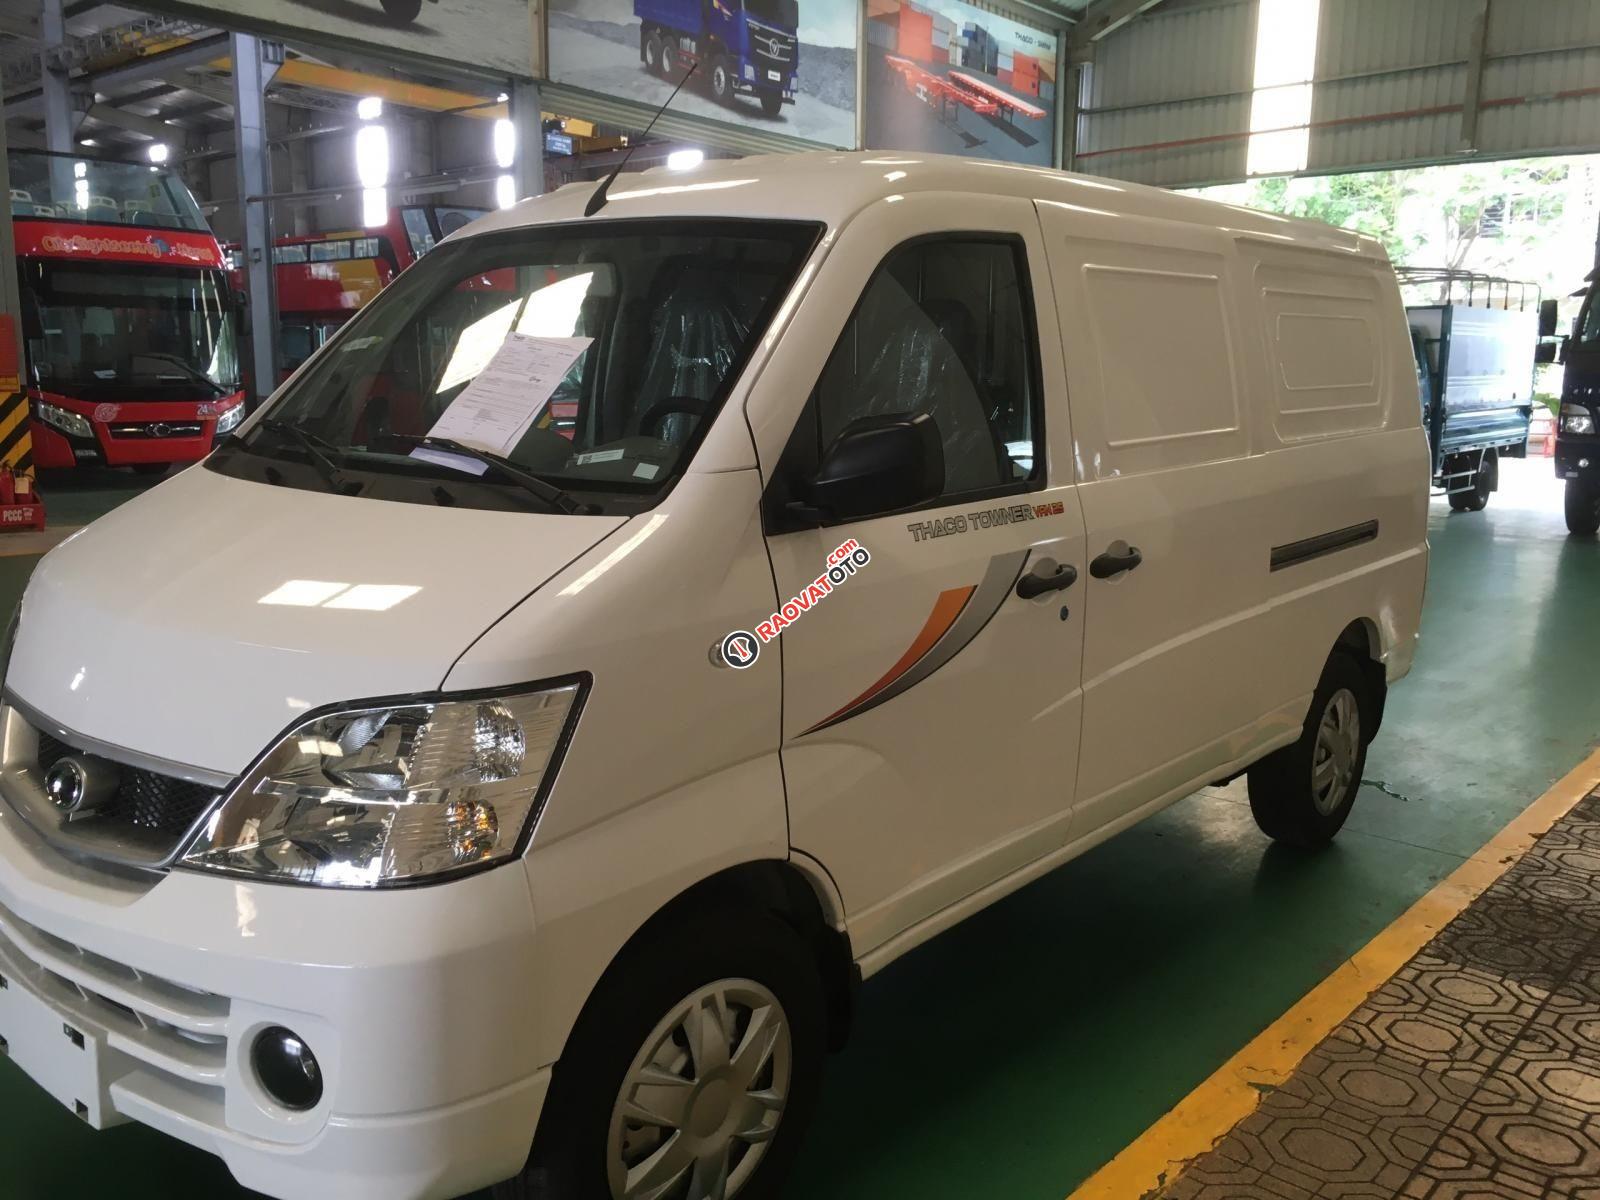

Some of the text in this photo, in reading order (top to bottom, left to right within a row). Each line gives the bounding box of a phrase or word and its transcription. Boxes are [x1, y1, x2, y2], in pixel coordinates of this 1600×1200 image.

[3, 507, 22, 522] PCCC
[907, 515, 968, 542] THACO
[968, 504, 1035, 531] TOWNER
